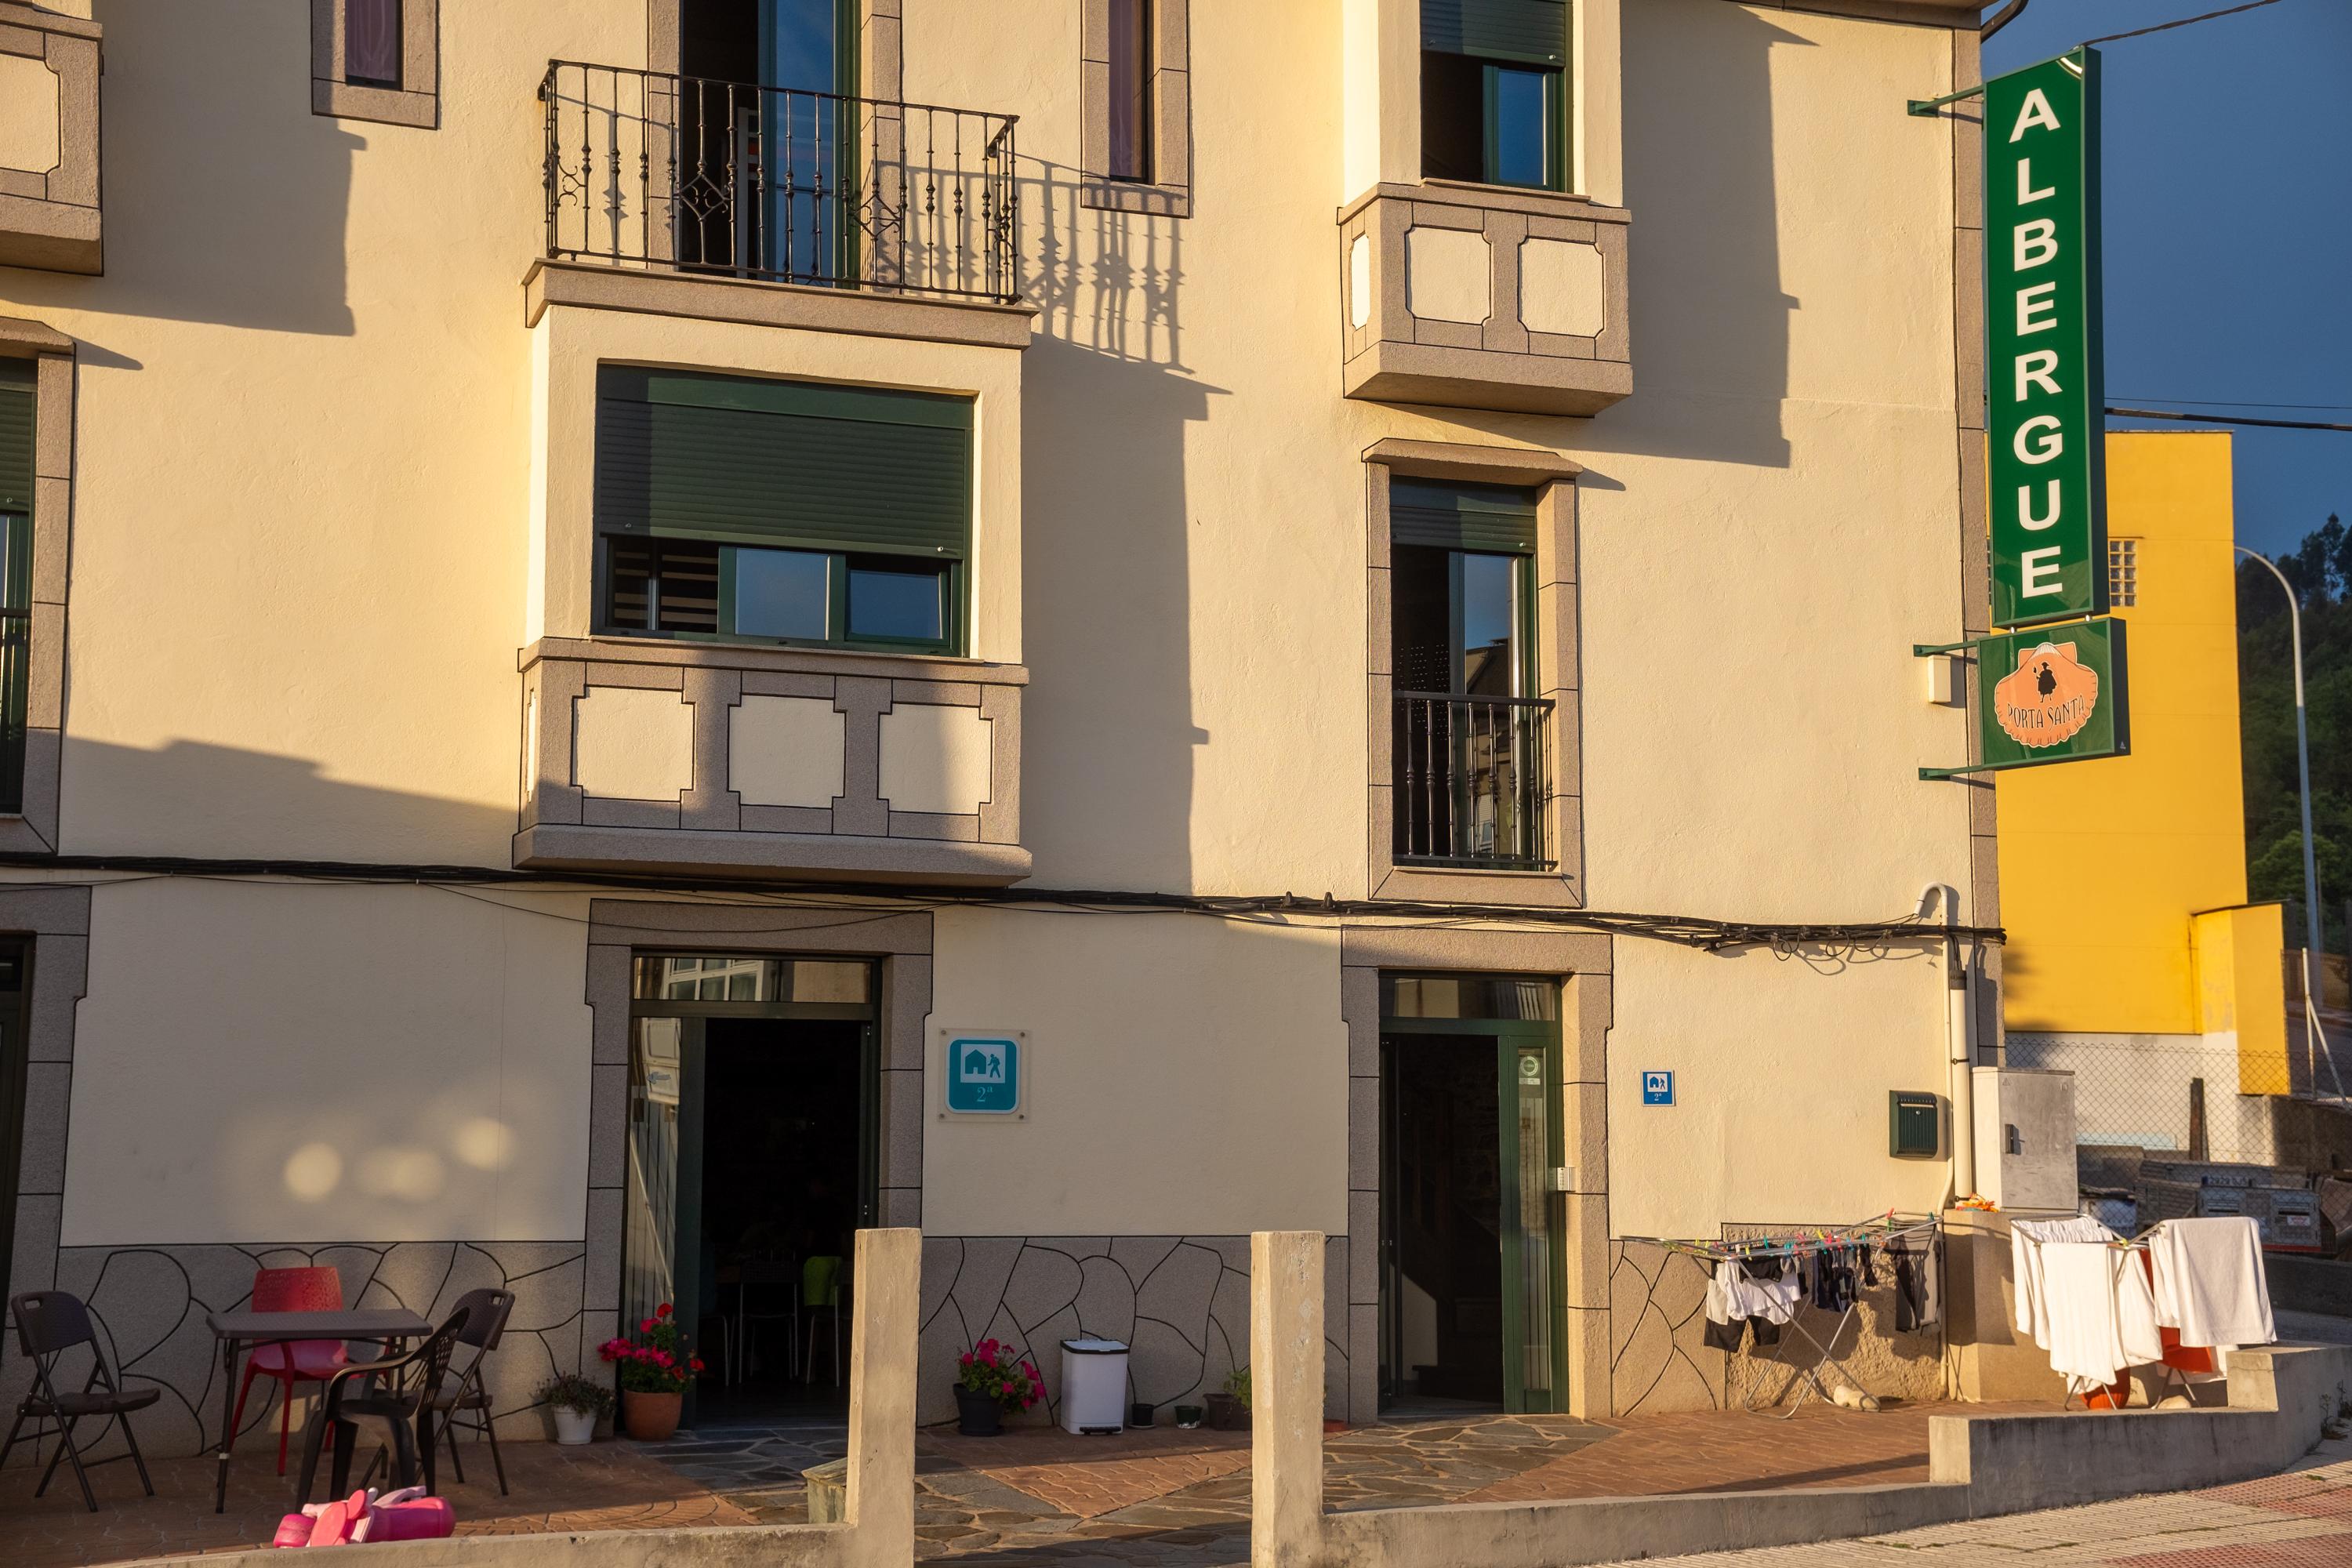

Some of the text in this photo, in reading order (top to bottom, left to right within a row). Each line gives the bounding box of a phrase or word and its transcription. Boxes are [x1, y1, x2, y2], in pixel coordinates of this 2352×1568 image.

[2009, 88, 2063, 598] ALBERGUE
[2008, 695, 2085, 731] PORTA SANTA
